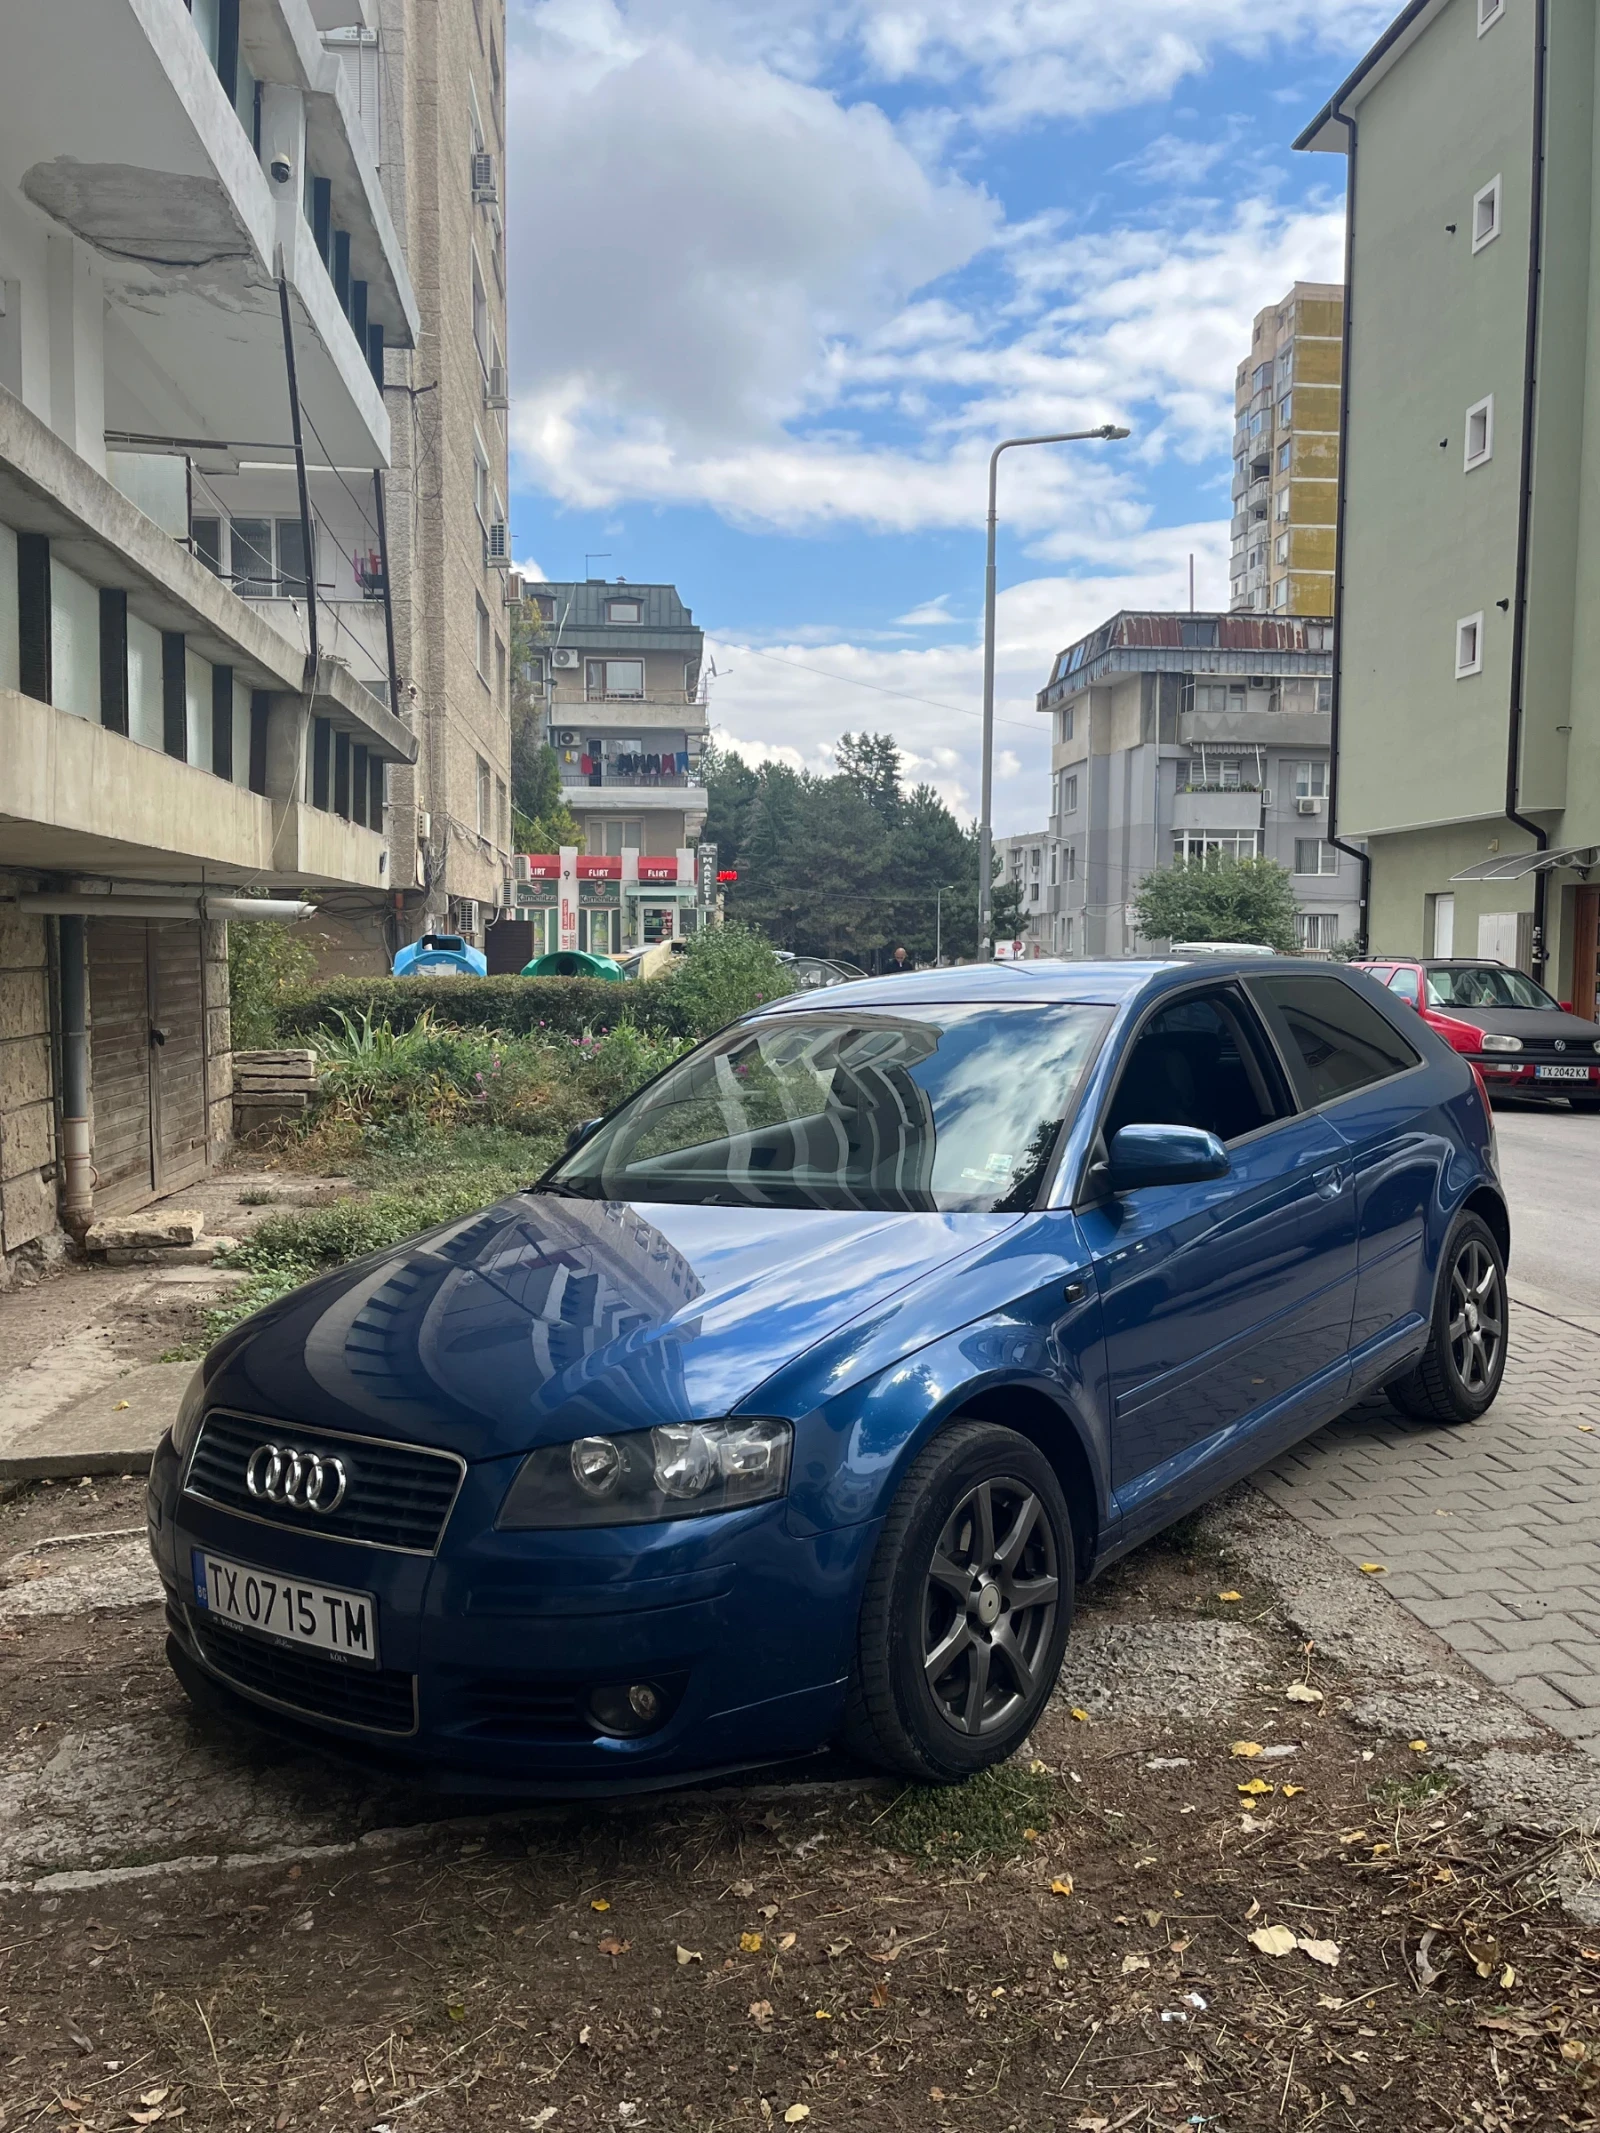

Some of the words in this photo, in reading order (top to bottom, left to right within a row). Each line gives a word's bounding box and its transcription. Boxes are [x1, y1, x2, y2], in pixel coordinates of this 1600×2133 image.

[530, 867, 546, 876] LIRT
[588, 869, 609, 877] FLIRT
[703, 857, 713, 898] MARKET
[196, 1584, 207, 1600] BG
[220, 1618, 244, 1632] VOLVO
[329, 1652, 348, 1663] KÖLN
